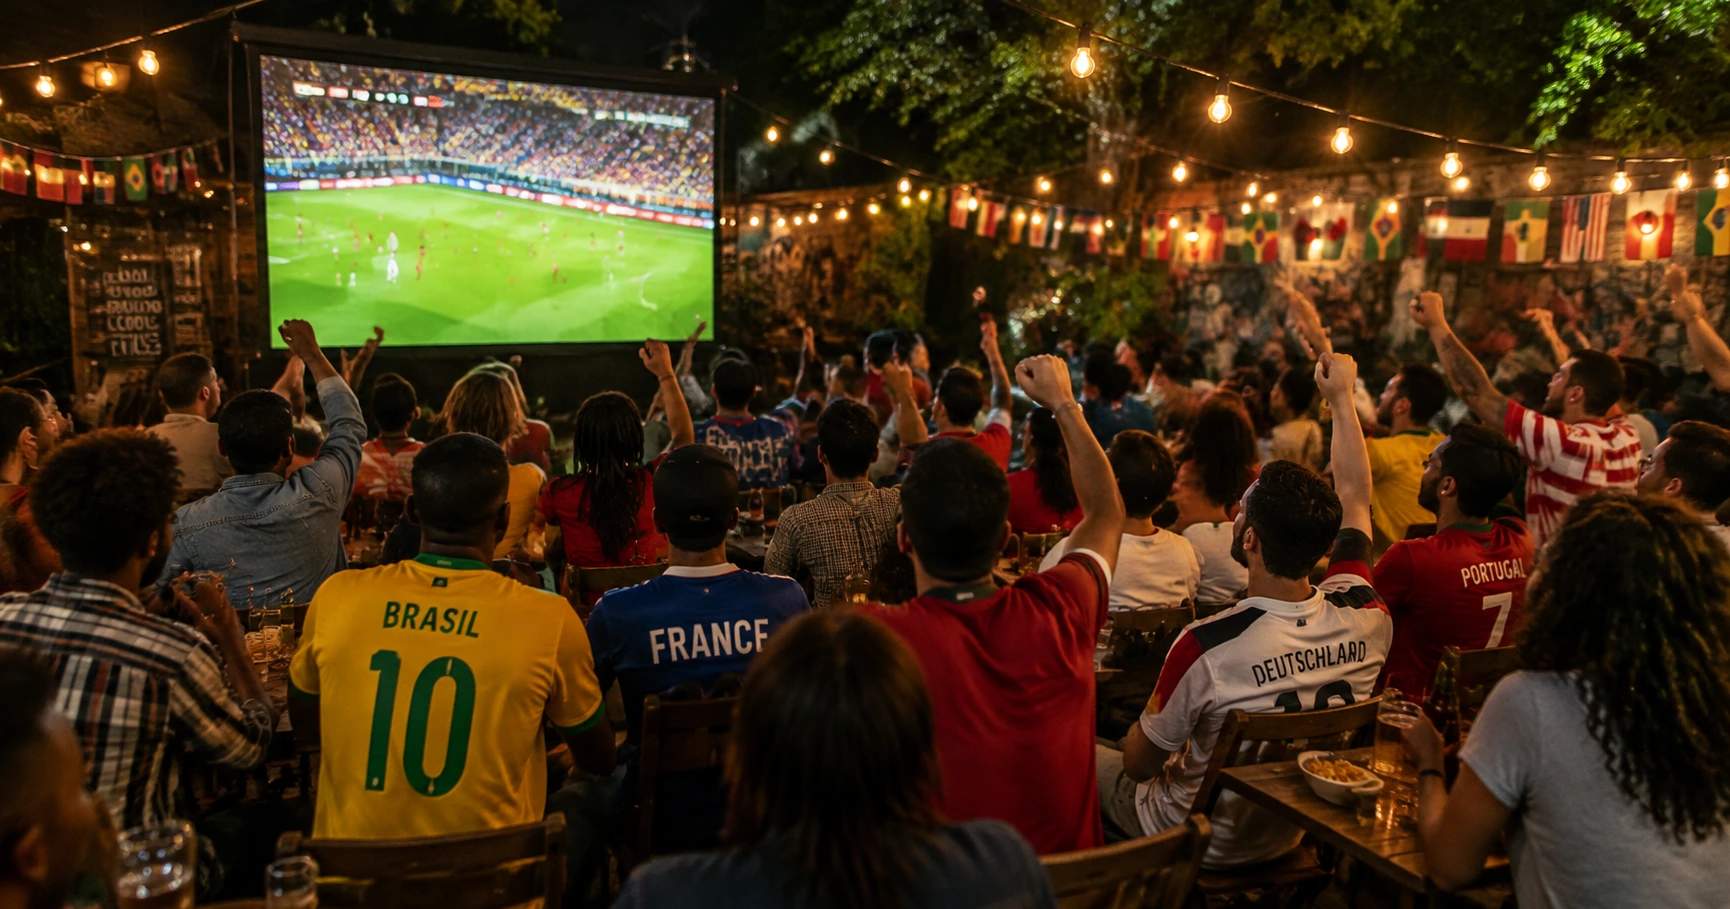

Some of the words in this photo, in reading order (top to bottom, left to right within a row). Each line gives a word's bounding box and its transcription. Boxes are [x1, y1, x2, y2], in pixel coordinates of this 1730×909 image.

[1461, 558, 1527, 588] PORTUGAL
[382, 601, 481, 638] BRASIL
[1482, 592, 1513, 649] 7
[365, 649, 477, 798] 10
